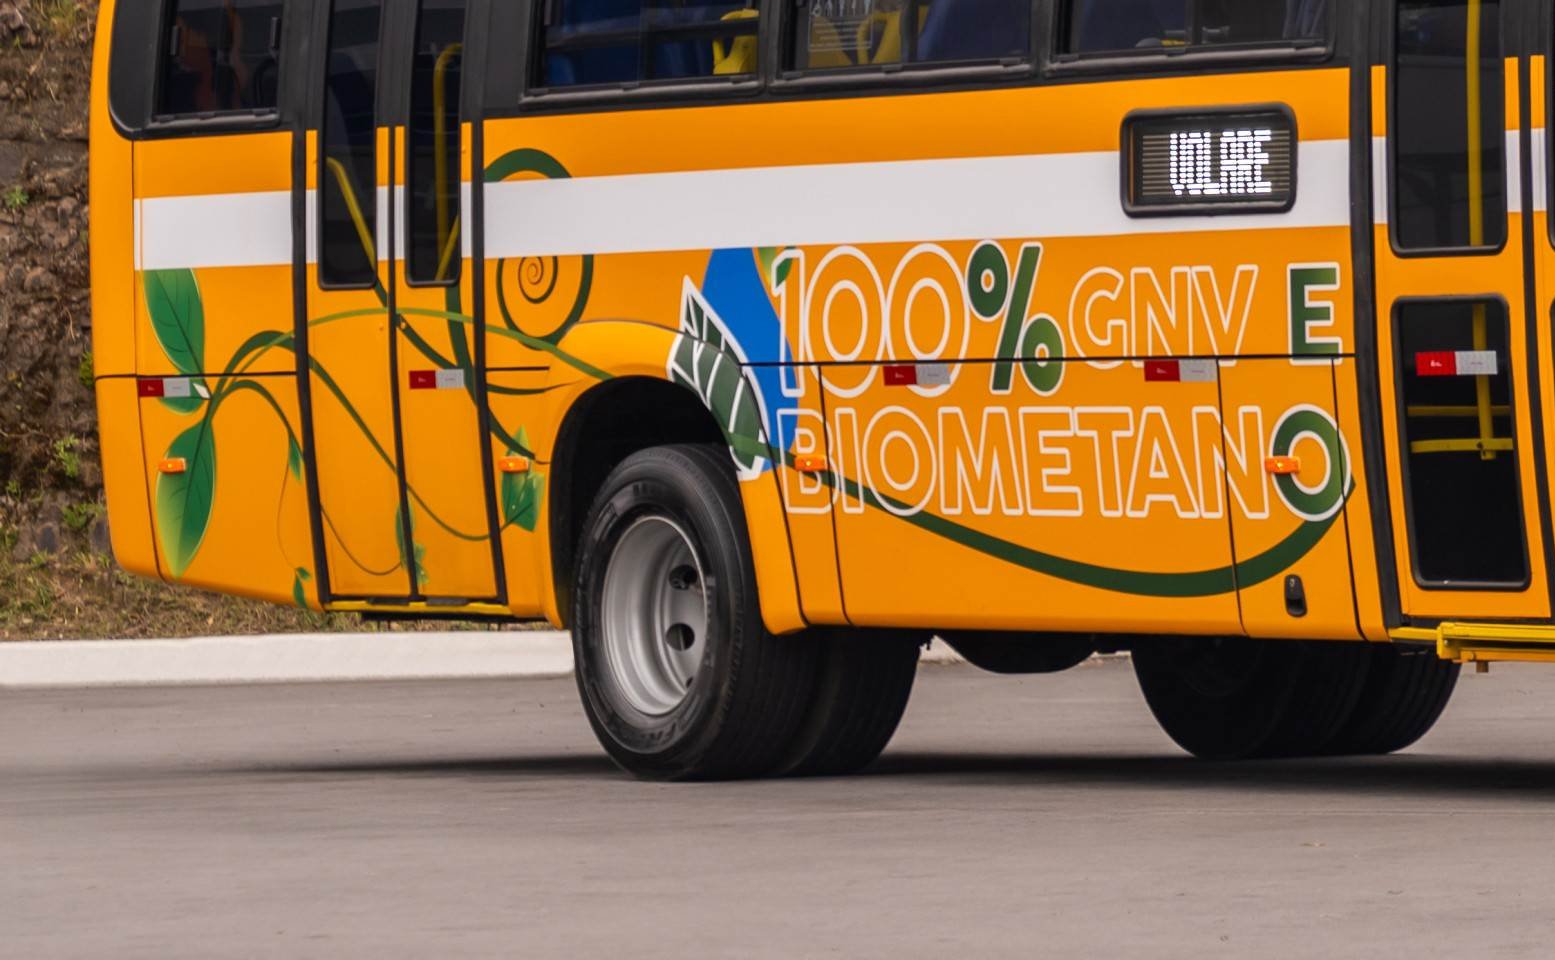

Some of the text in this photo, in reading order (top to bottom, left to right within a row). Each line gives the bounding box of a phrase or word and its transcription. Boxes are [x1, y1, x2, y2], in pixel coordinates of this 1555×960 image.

[1169, 129, 1272, 196] VOLARE
[771, 240, 1343, 398] 100% GNV E
[776, 404, 1352, 523] BIOMETANO
